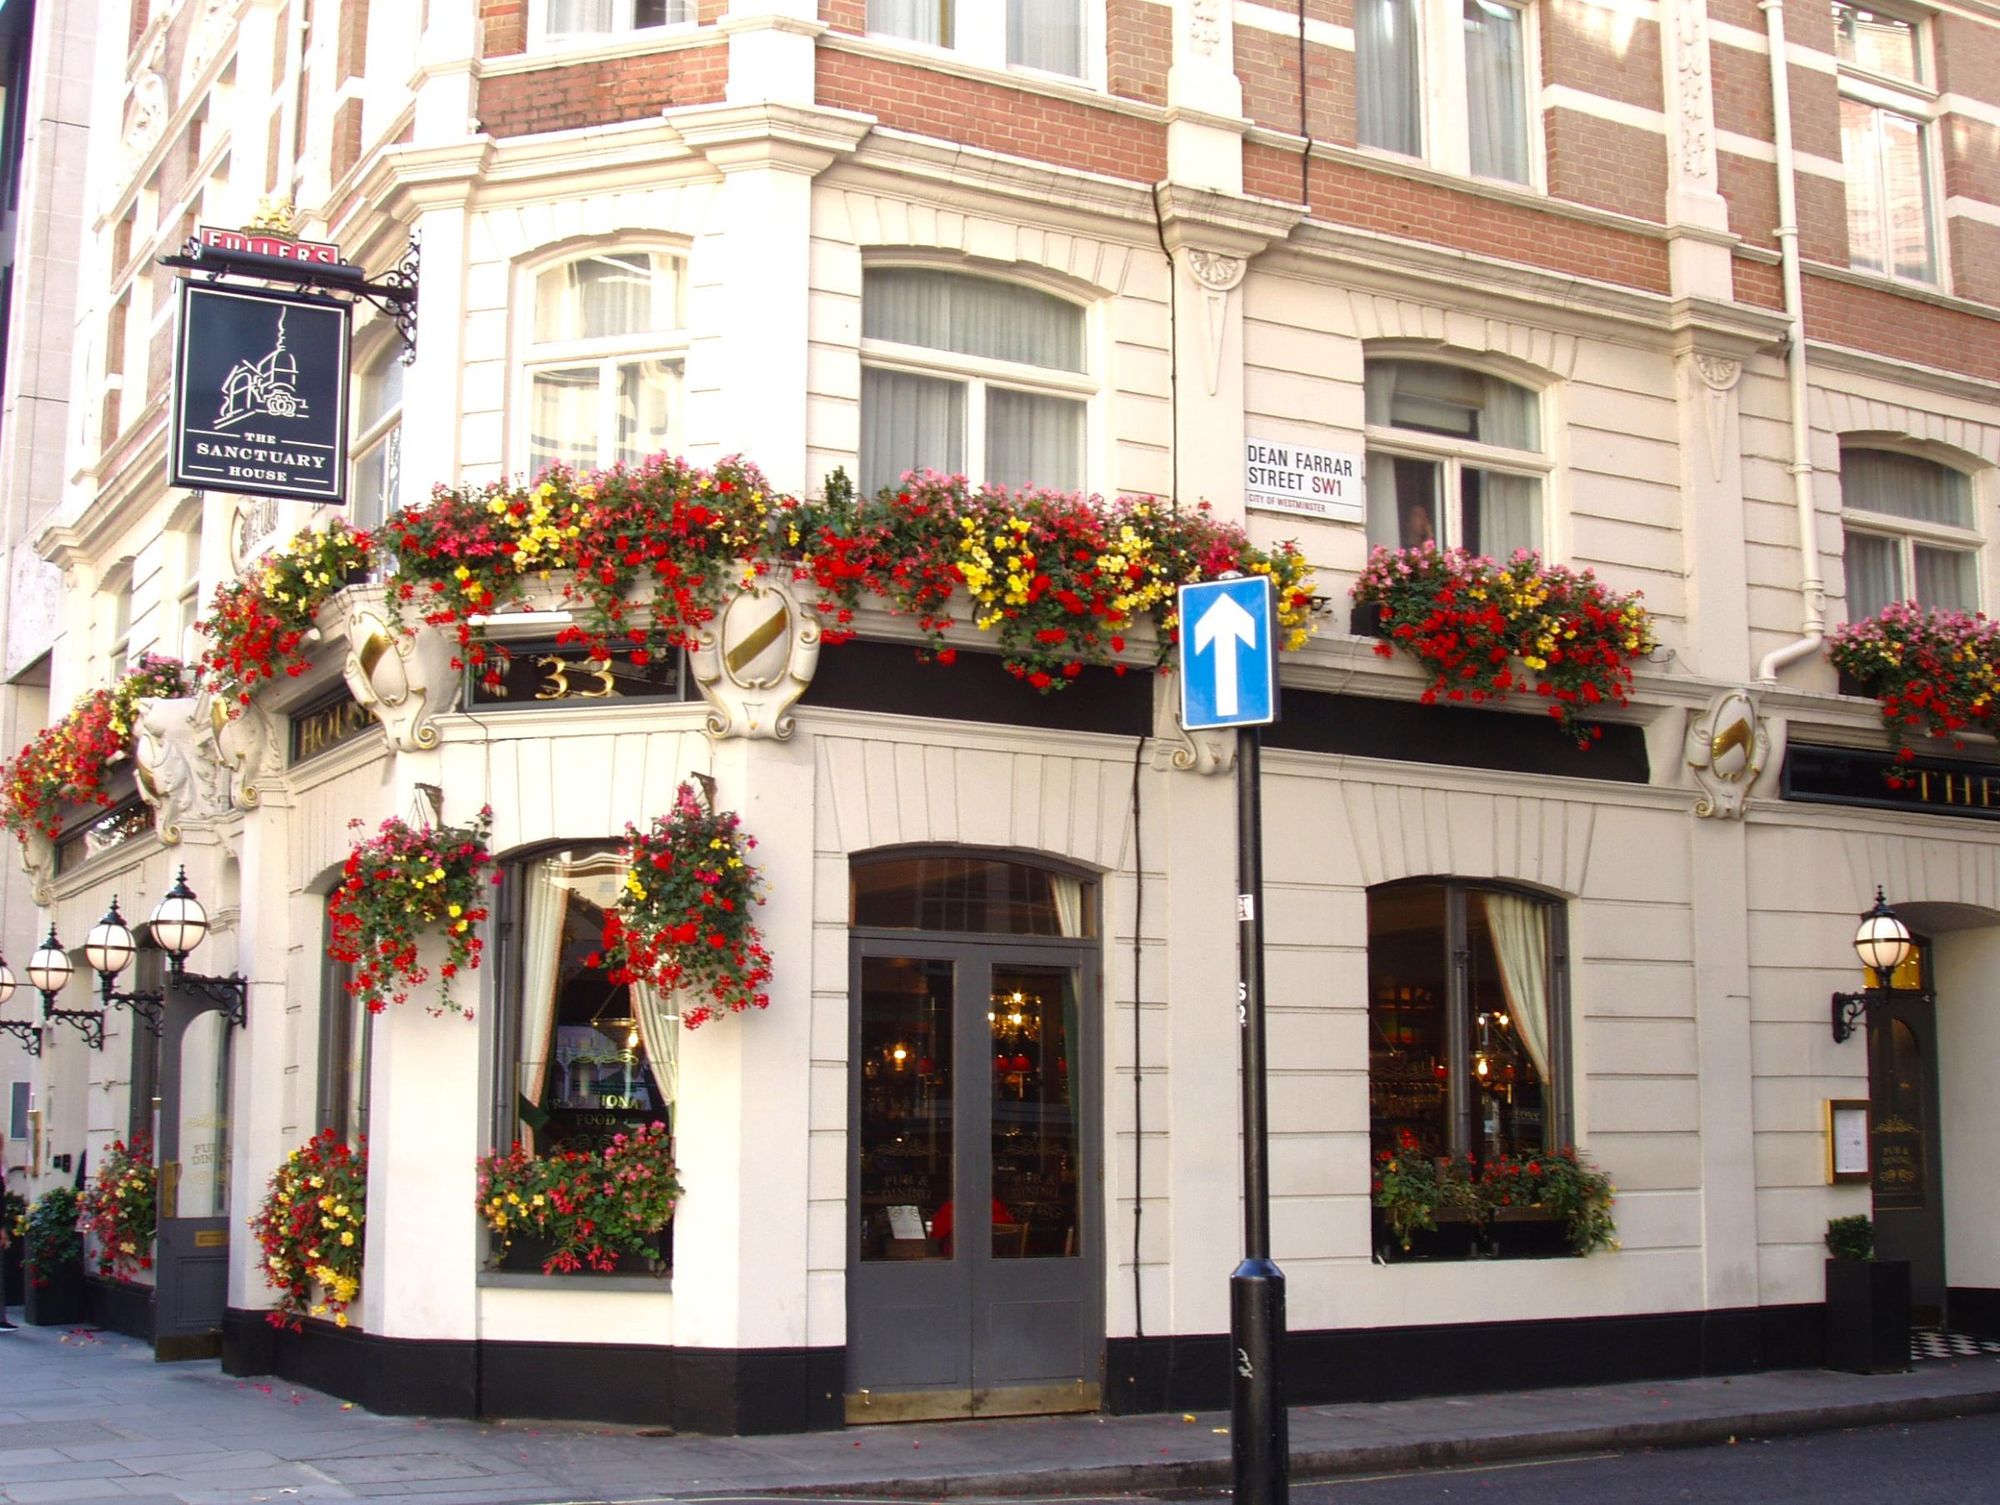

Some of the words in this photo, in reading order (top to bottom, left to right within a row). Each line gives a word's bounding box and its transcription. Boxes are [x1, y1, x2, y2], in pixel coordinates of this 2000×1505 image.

[208, 231, 329, 263] FULLER'S
[244, 432, 277, 444] THE
[196, 442, 326, 469] SANCTUARY
[1248, 444, 1289, 467] DEAN
[1296, 452, 1353, 477] FARRAR
[229, 465, 288, 482] HOUSE
[1248, 466, 1305, 491] STREET
[1312, 476, 1342, 496] SW1
[1248, 493, 1264, 504] CITY
[1266, 496, 1275, 505] OF
[1277, 498, 1326, 513] WESTMINSTER
[576, 1113, 616, 1127] FOOD
